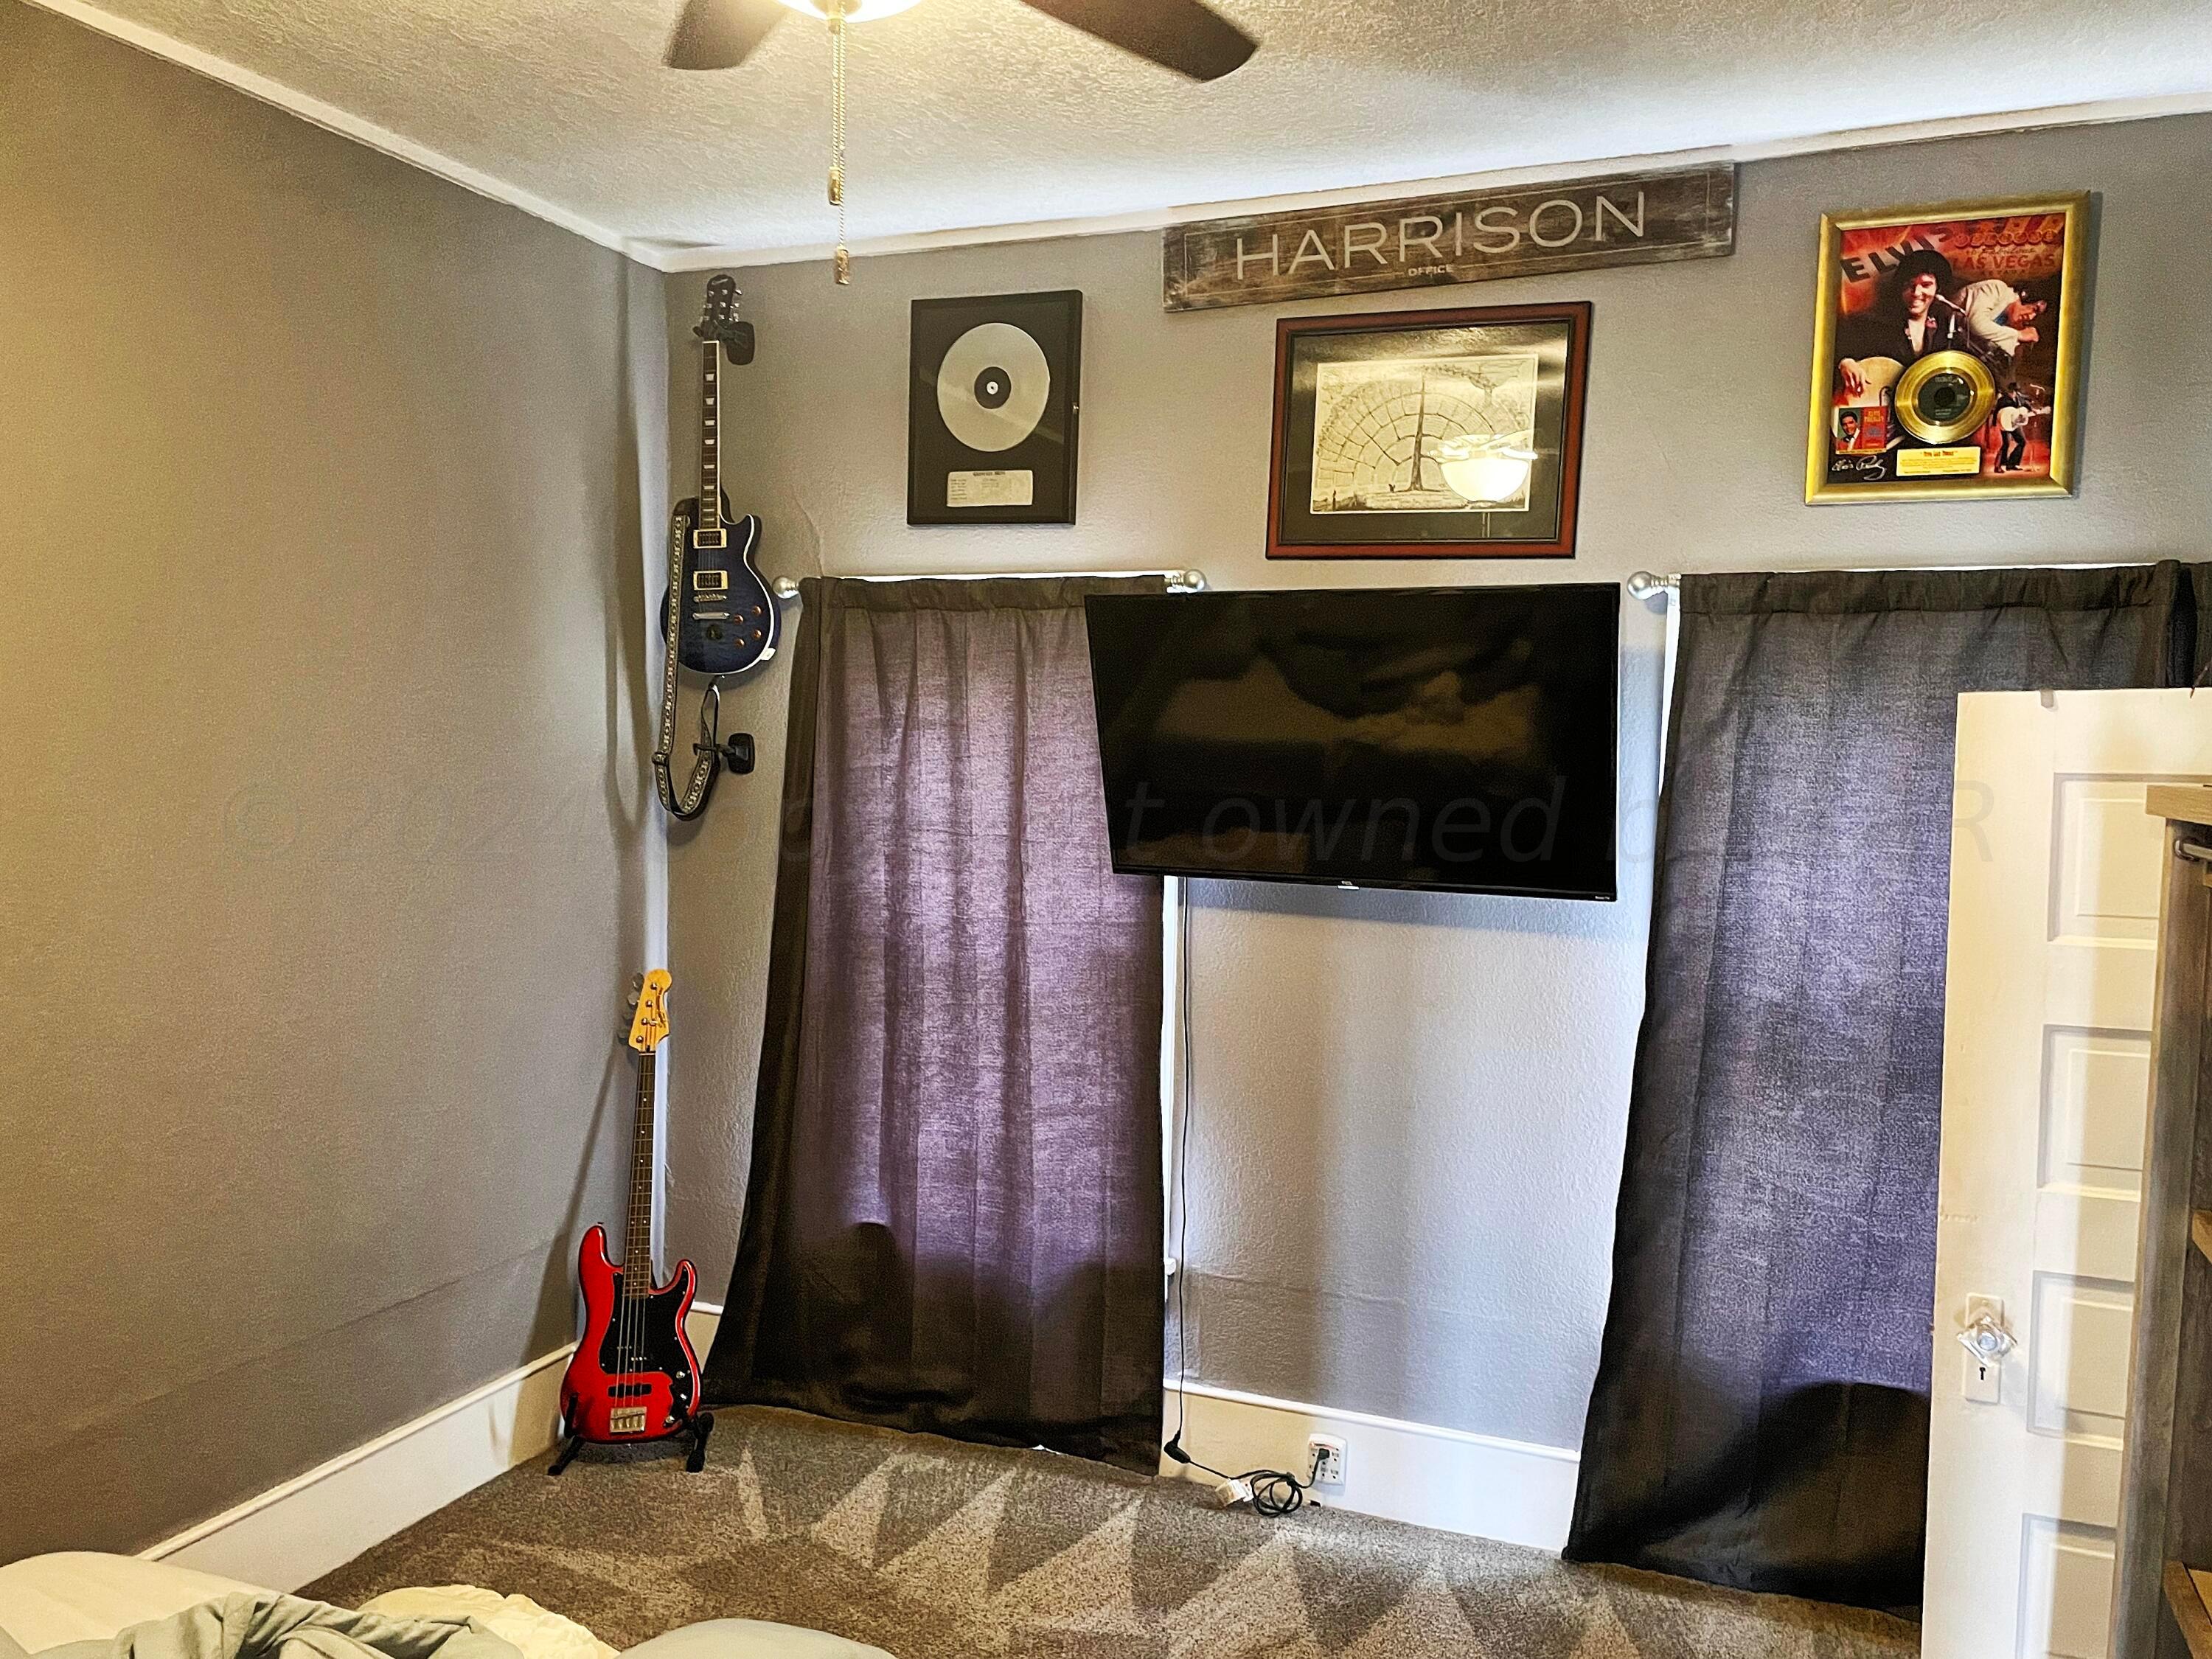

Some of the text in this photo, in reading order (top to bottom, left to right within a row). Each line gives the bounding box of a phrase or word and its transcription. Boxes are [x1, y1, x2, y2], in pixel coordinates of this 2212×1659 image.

[1236, 191, 1644, 280] HARRISON
[1993, 254, 2055, 268] VEGAS
[1408, 263, 1455, 276] OFFICE
